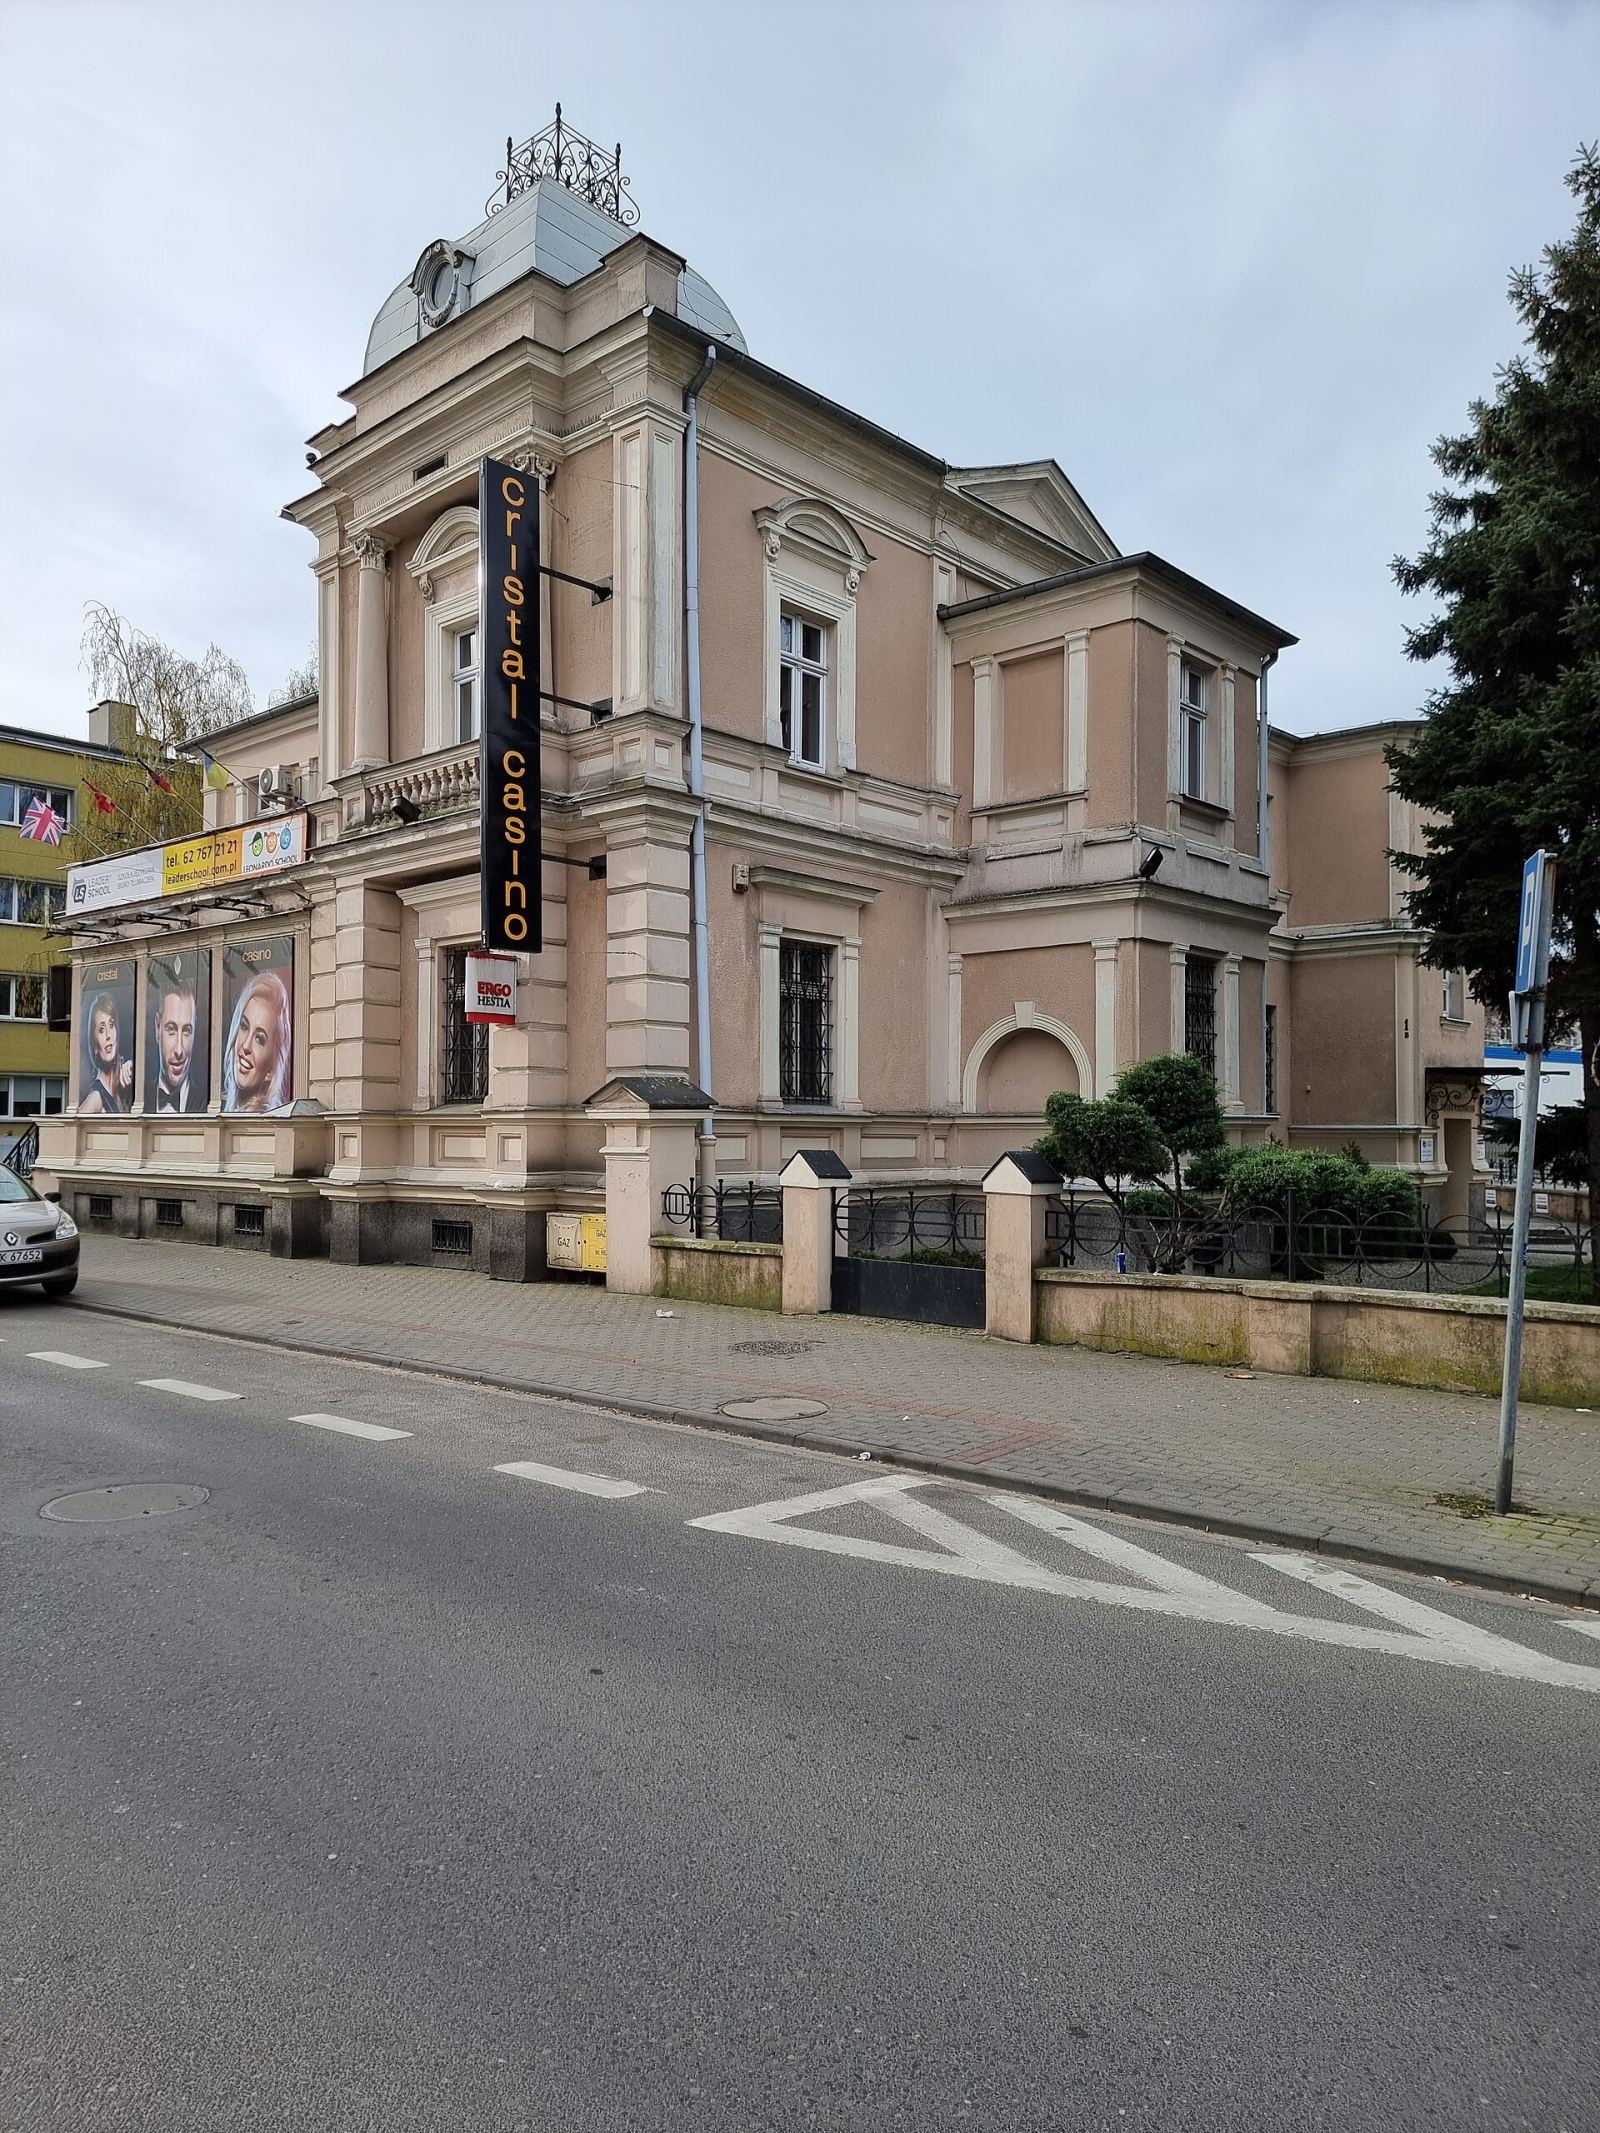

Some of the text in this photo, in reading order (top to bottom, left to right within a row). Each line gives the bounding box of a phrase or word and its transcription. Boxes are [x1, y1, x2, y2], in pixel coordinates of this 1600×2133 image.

[502, 477, 527, 941] cristal casino
[166, 840, 237, 868] tel. 62 767 21 21
[243, 854, 298, 873] LEONARDO SCHOOL
[165, 860, 237, 885] leaderschool.com.pl
[88, 875, 110, 888] LEADER
[88, 885, 111, 898] SCHOOL
[1519, 872, 1535, 977] P
[242, 948, 272, 962] casino
[477, 981, 512, 997] ERGO
[477, 996, 511, 1009] HESTIA
[557, 1237, 571, 1247] GAZ
[10, 1250, 40, 1262] 67652
